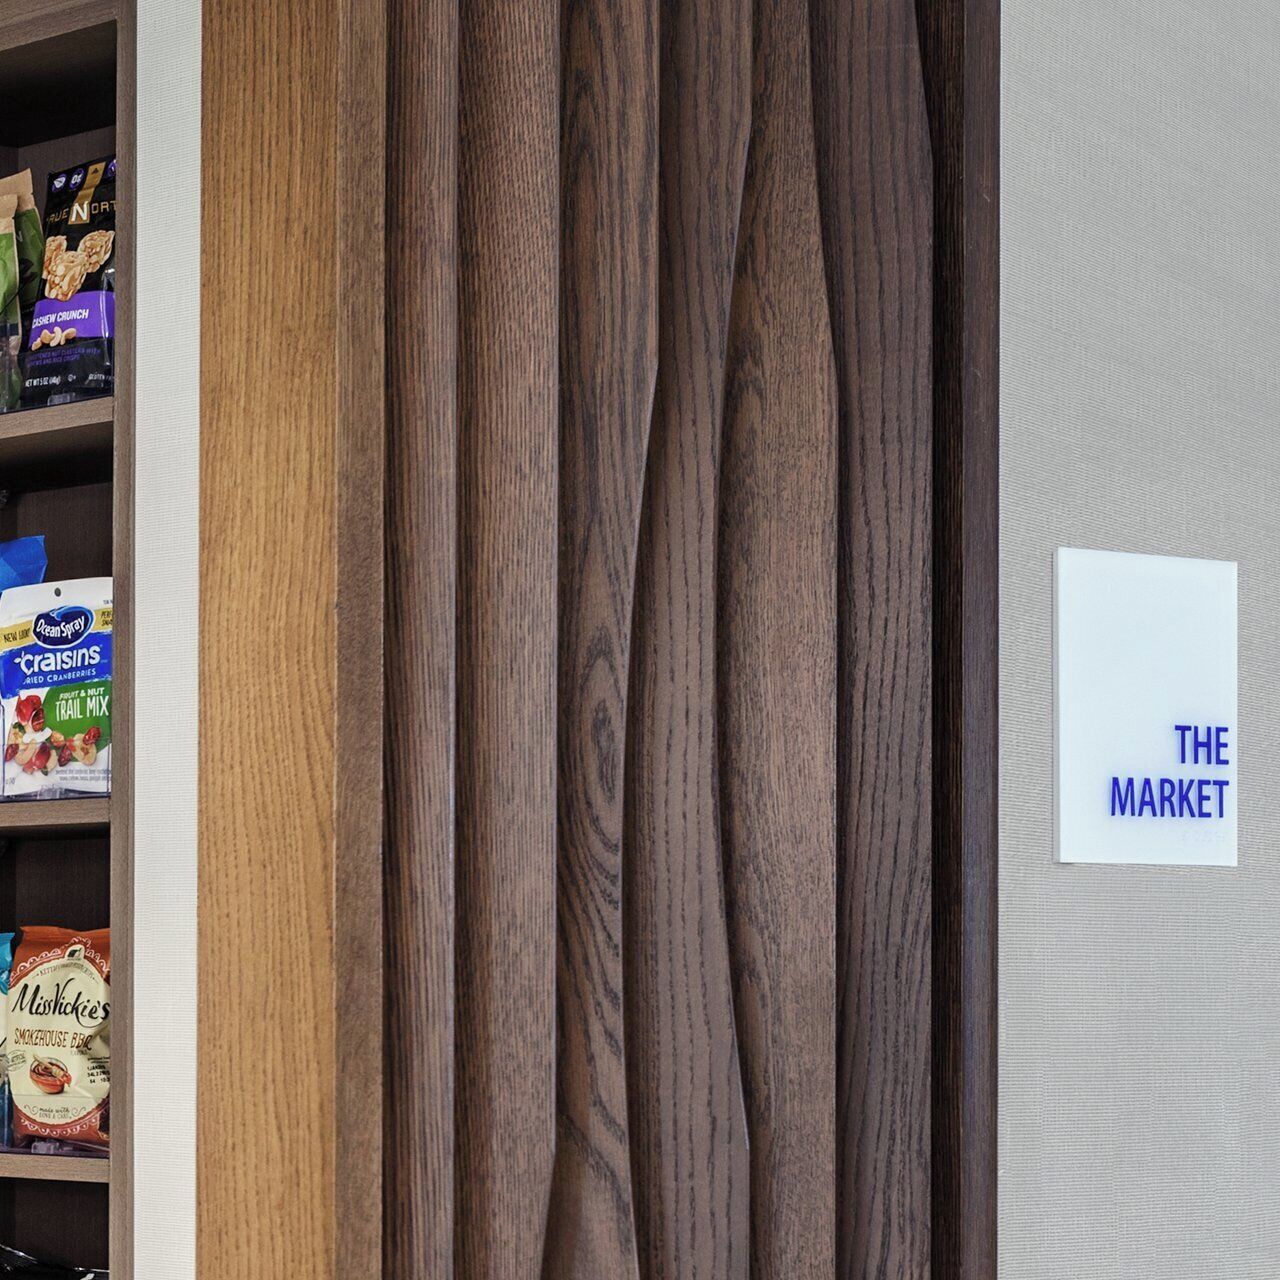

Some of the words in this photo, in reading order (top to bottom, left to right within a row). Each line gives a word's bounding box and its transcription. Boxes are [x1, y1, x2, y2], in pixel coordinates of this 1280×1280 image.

[32, 313, 55, 329] CASHEW
[57, 308, 89, 323] CRUNCH
[47, 668, 96, 682] CRANBERRIES
[55, 700, 83, 721] TRAIL
[87, 696, 109, 717] MIX
[1174, 725, 1229, 765] THE
[1110, 776, 1229, 818] MARKET
[14, 1028, 69, 1047] SMOKEHOUSE
[71, 1035, 92, 1050] BBQ
